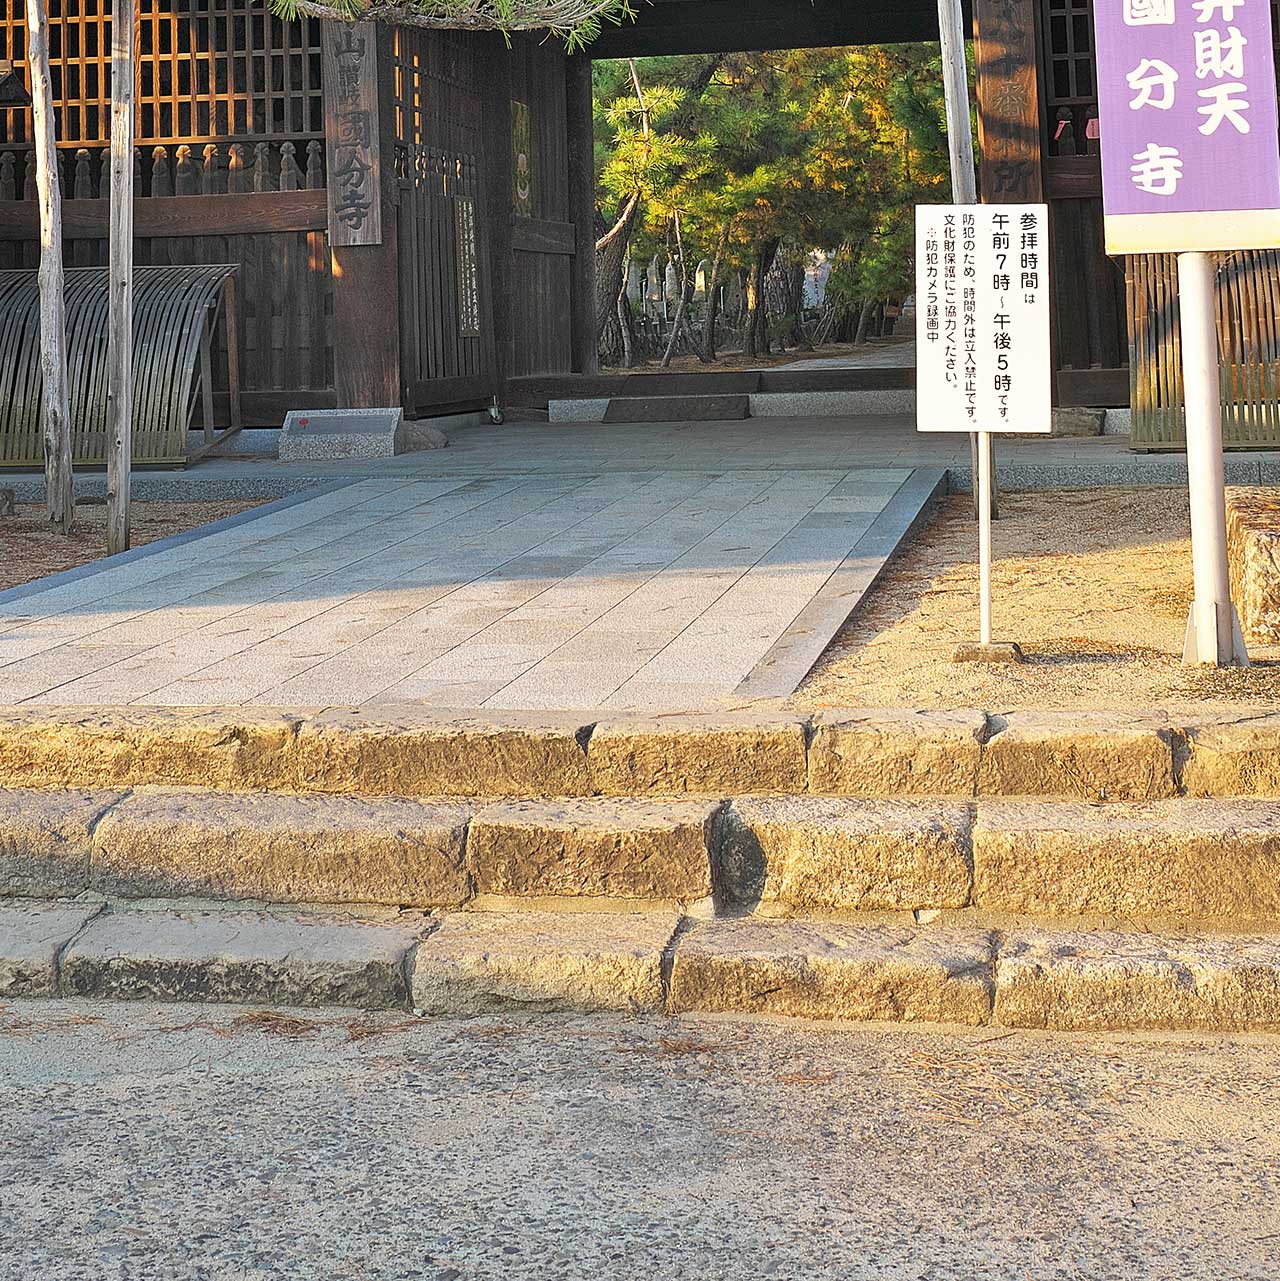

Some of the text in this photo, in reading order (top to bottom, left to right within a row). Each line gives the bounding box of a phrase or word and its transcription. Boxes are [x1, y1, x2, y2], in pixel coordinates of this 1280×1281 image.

[943, 214, 958, 389] 文化財保護にご協力ください。
[962, 213, 977, 424] 防犯のため、時間外は立入禁止です。
[1019, 213, 1039, 304] 参拝時間は
